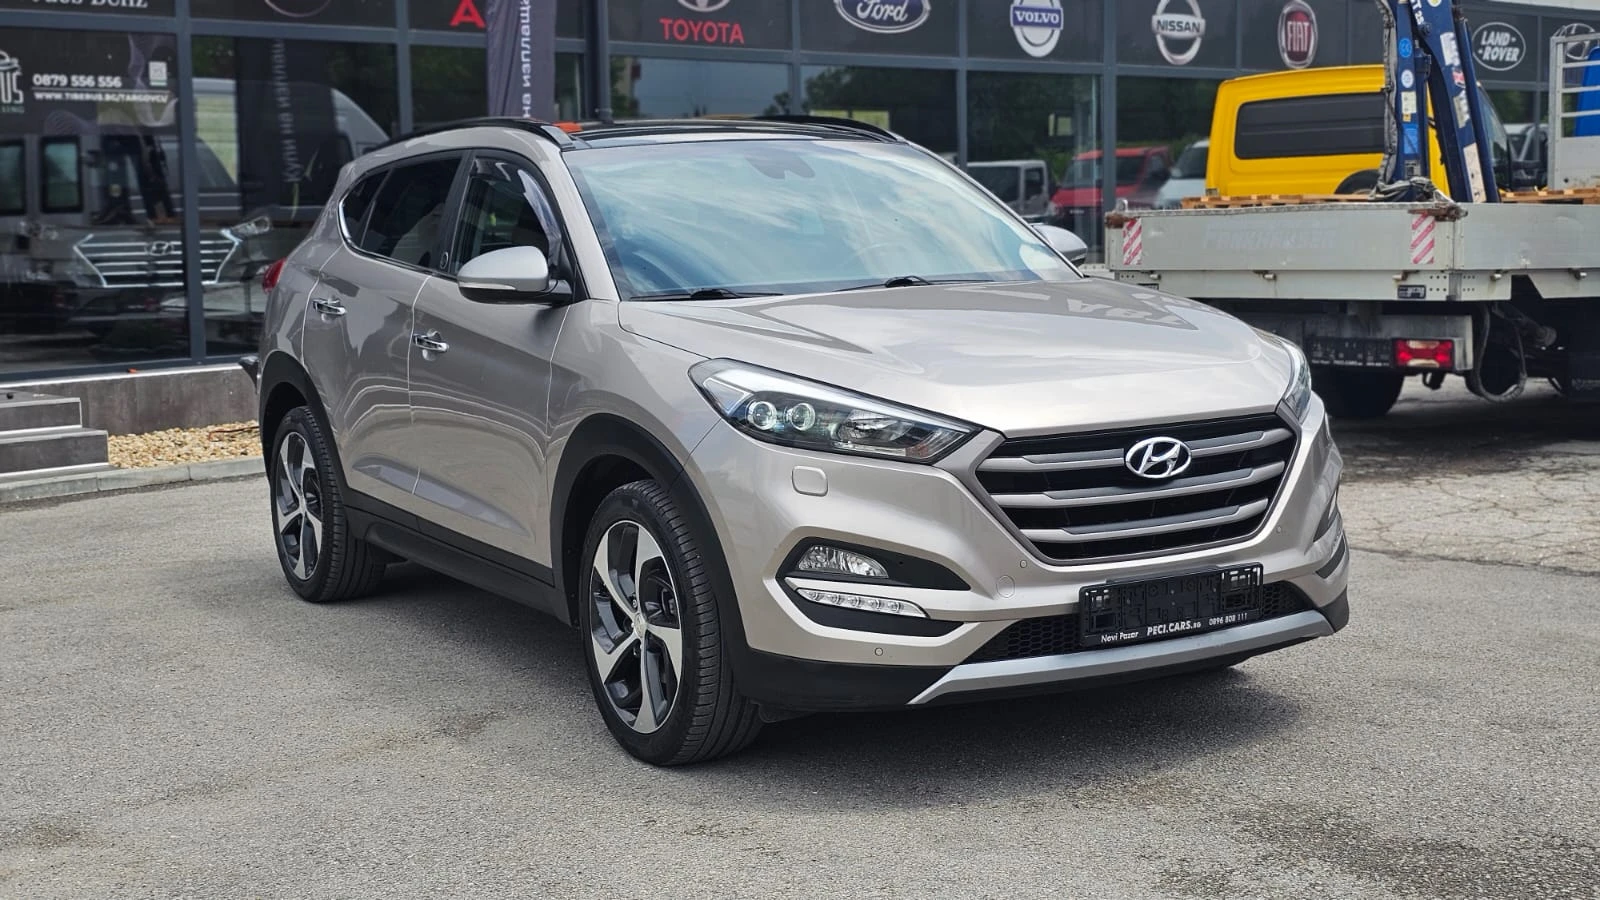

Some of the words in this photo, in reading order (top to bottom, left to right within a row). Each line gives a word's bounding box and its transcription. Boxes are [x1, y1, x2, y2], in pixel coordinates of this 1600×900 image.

[1014, 10, 1060, 24] VOLVO
[659, 18, 745, 44] TOYOTA
[1156, 20, 1200, 33] NISSAN
[1287, 21, 1310, 52] FIAT
[33, 74, 68, 86] 0879
[71, 75, 96, 87] 556
[97, 76, 122, 88] 556
[1120, 631, 1139, 640] Pazar
